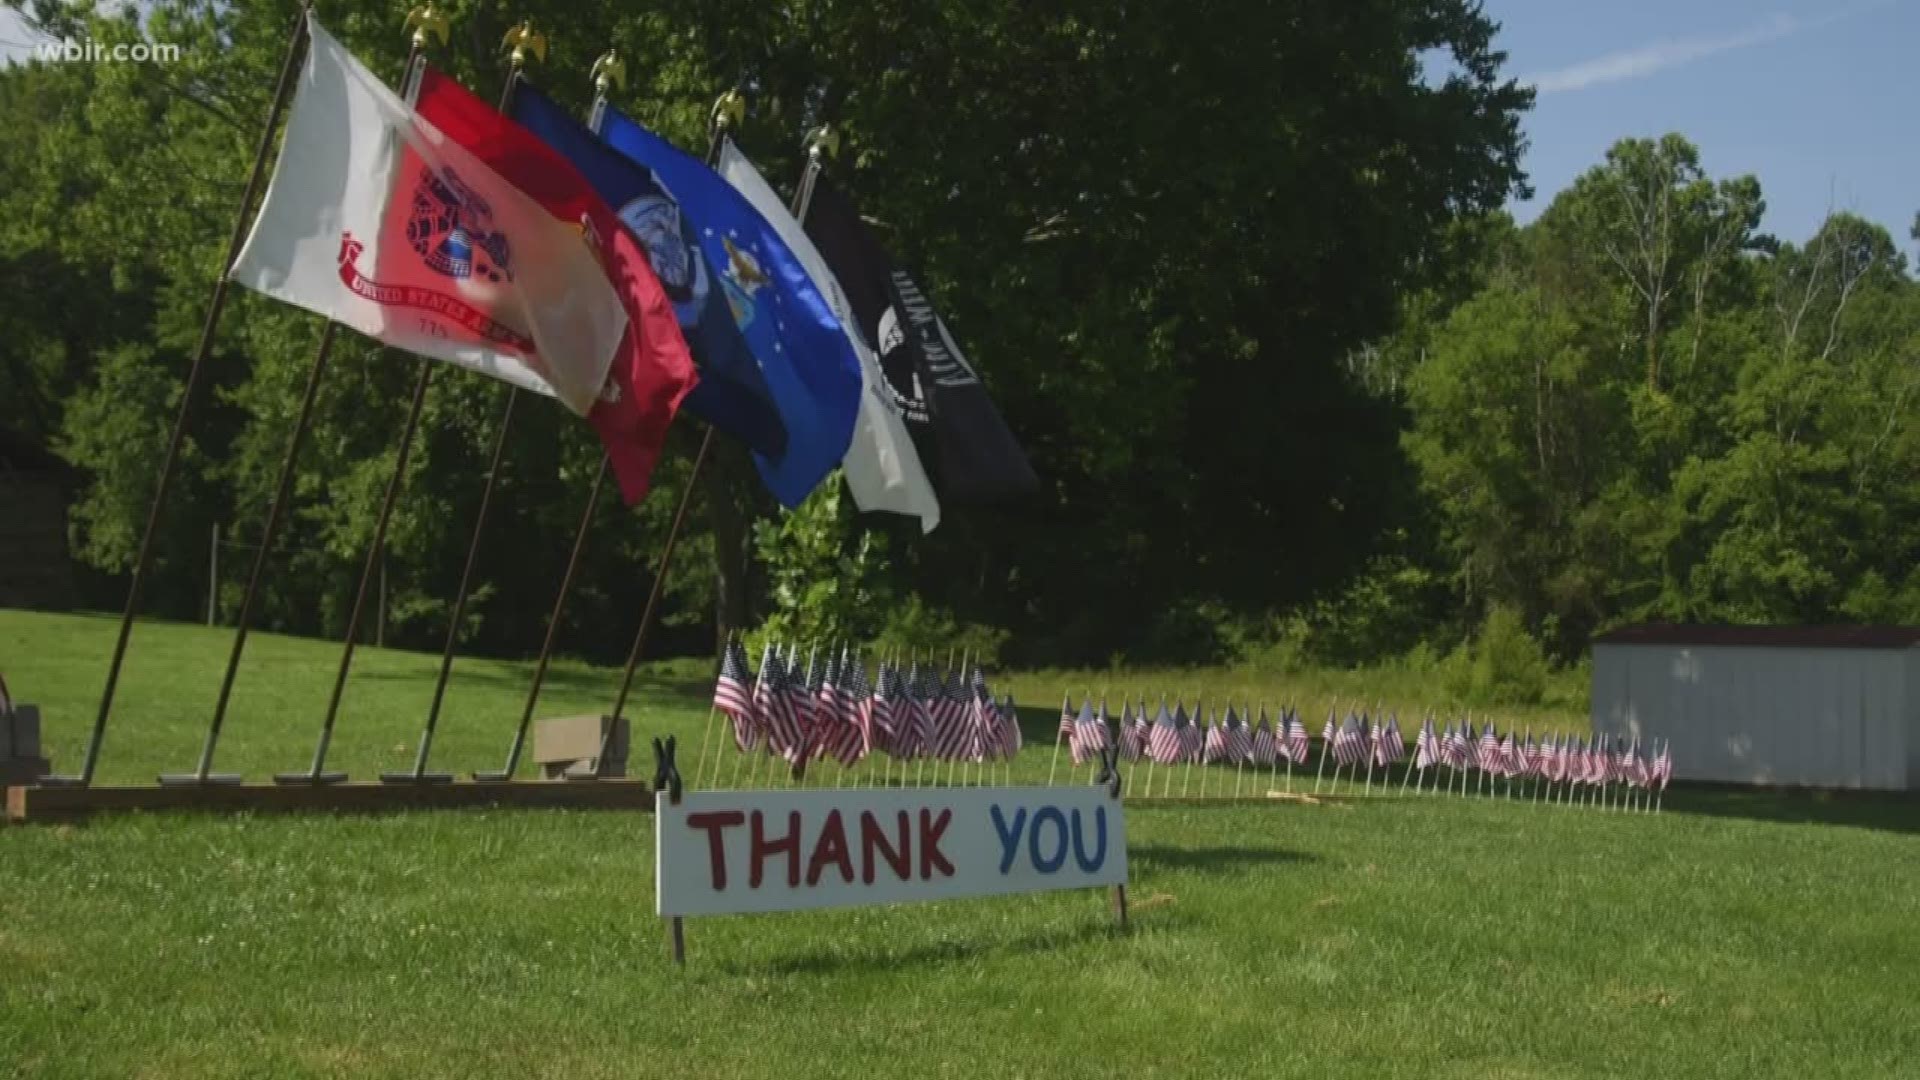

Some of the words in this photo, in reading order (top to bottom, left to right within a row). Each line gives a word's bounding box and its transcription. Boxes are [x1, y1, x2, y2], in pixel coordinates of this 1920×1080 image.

[352, 274, 402, 300] UNITED
[407, 286, 468, 320] STATES
[686, 808, 955, 891] THANK
[990, 804, 1107, 875] YOU
